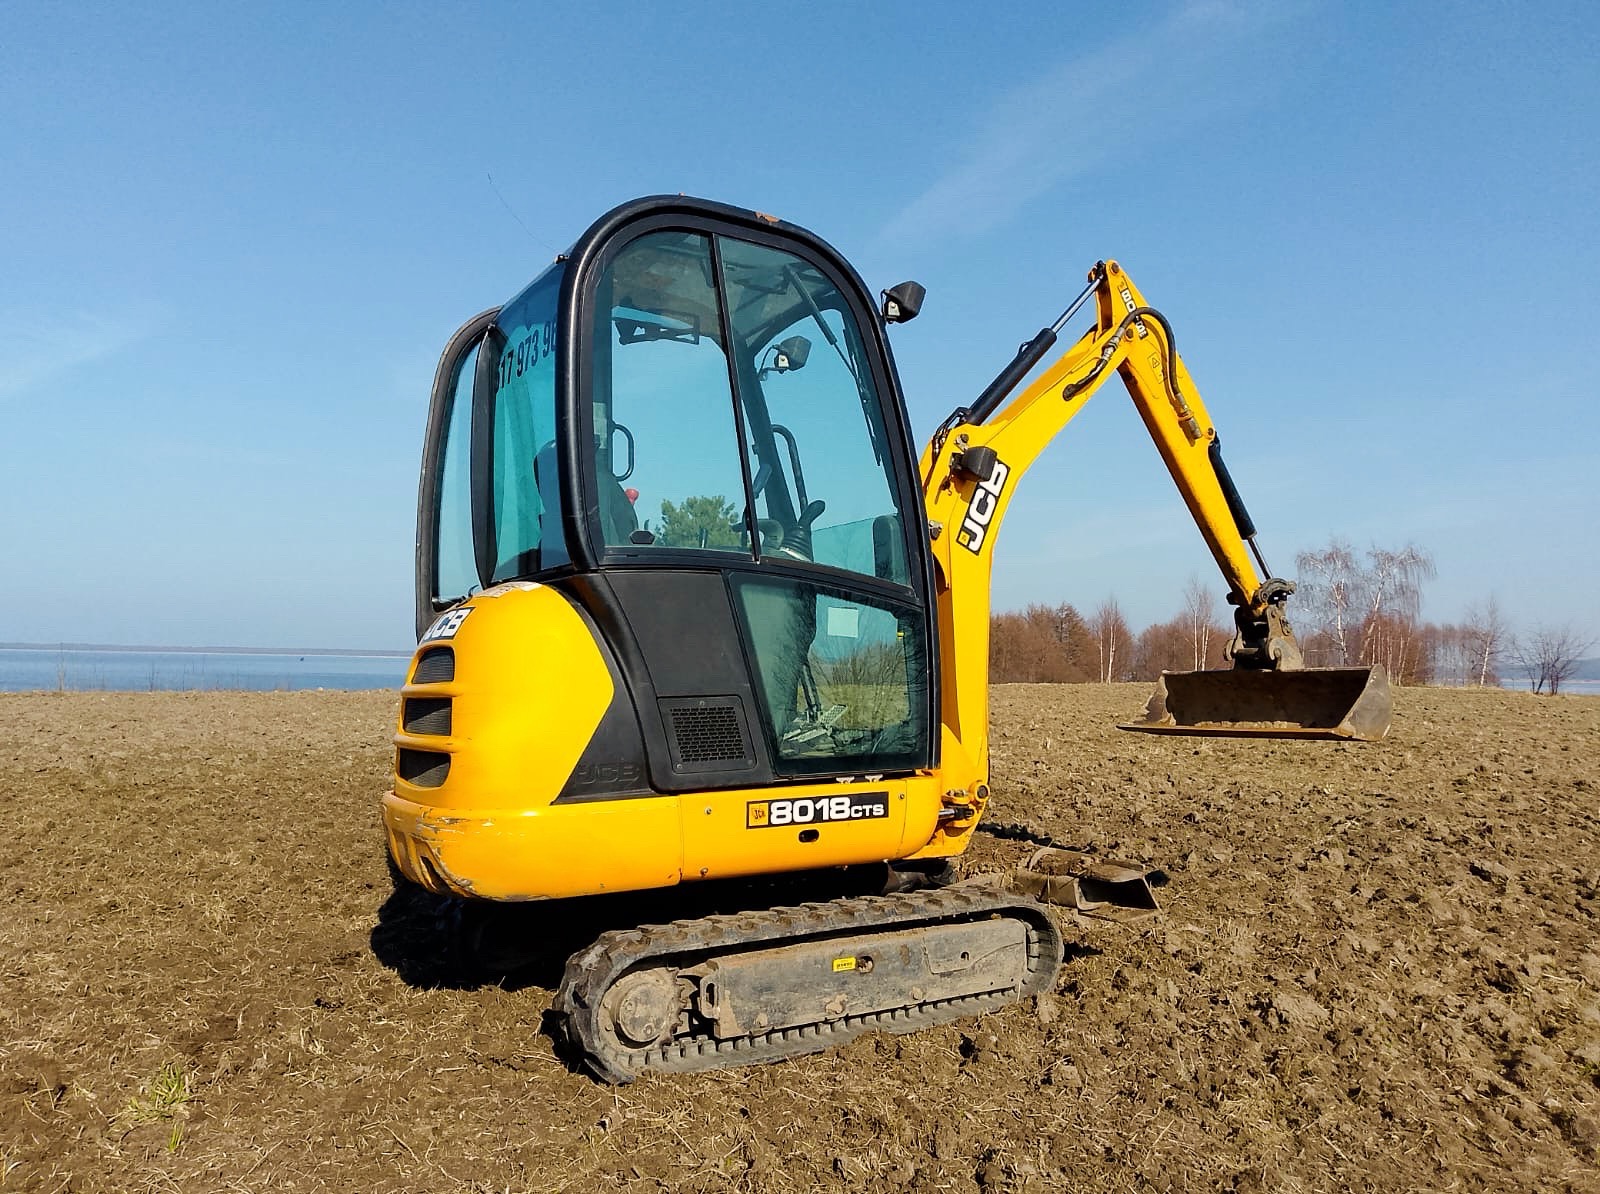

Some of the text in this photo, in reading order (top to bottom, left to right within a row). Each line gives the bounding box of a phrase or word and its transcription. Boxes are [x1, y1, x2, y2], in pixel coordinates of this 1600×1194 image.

[517, 329, 539, 377] 973
[770, 796, 851, 825] 8018
[850, 803, 885, 818] CTS
